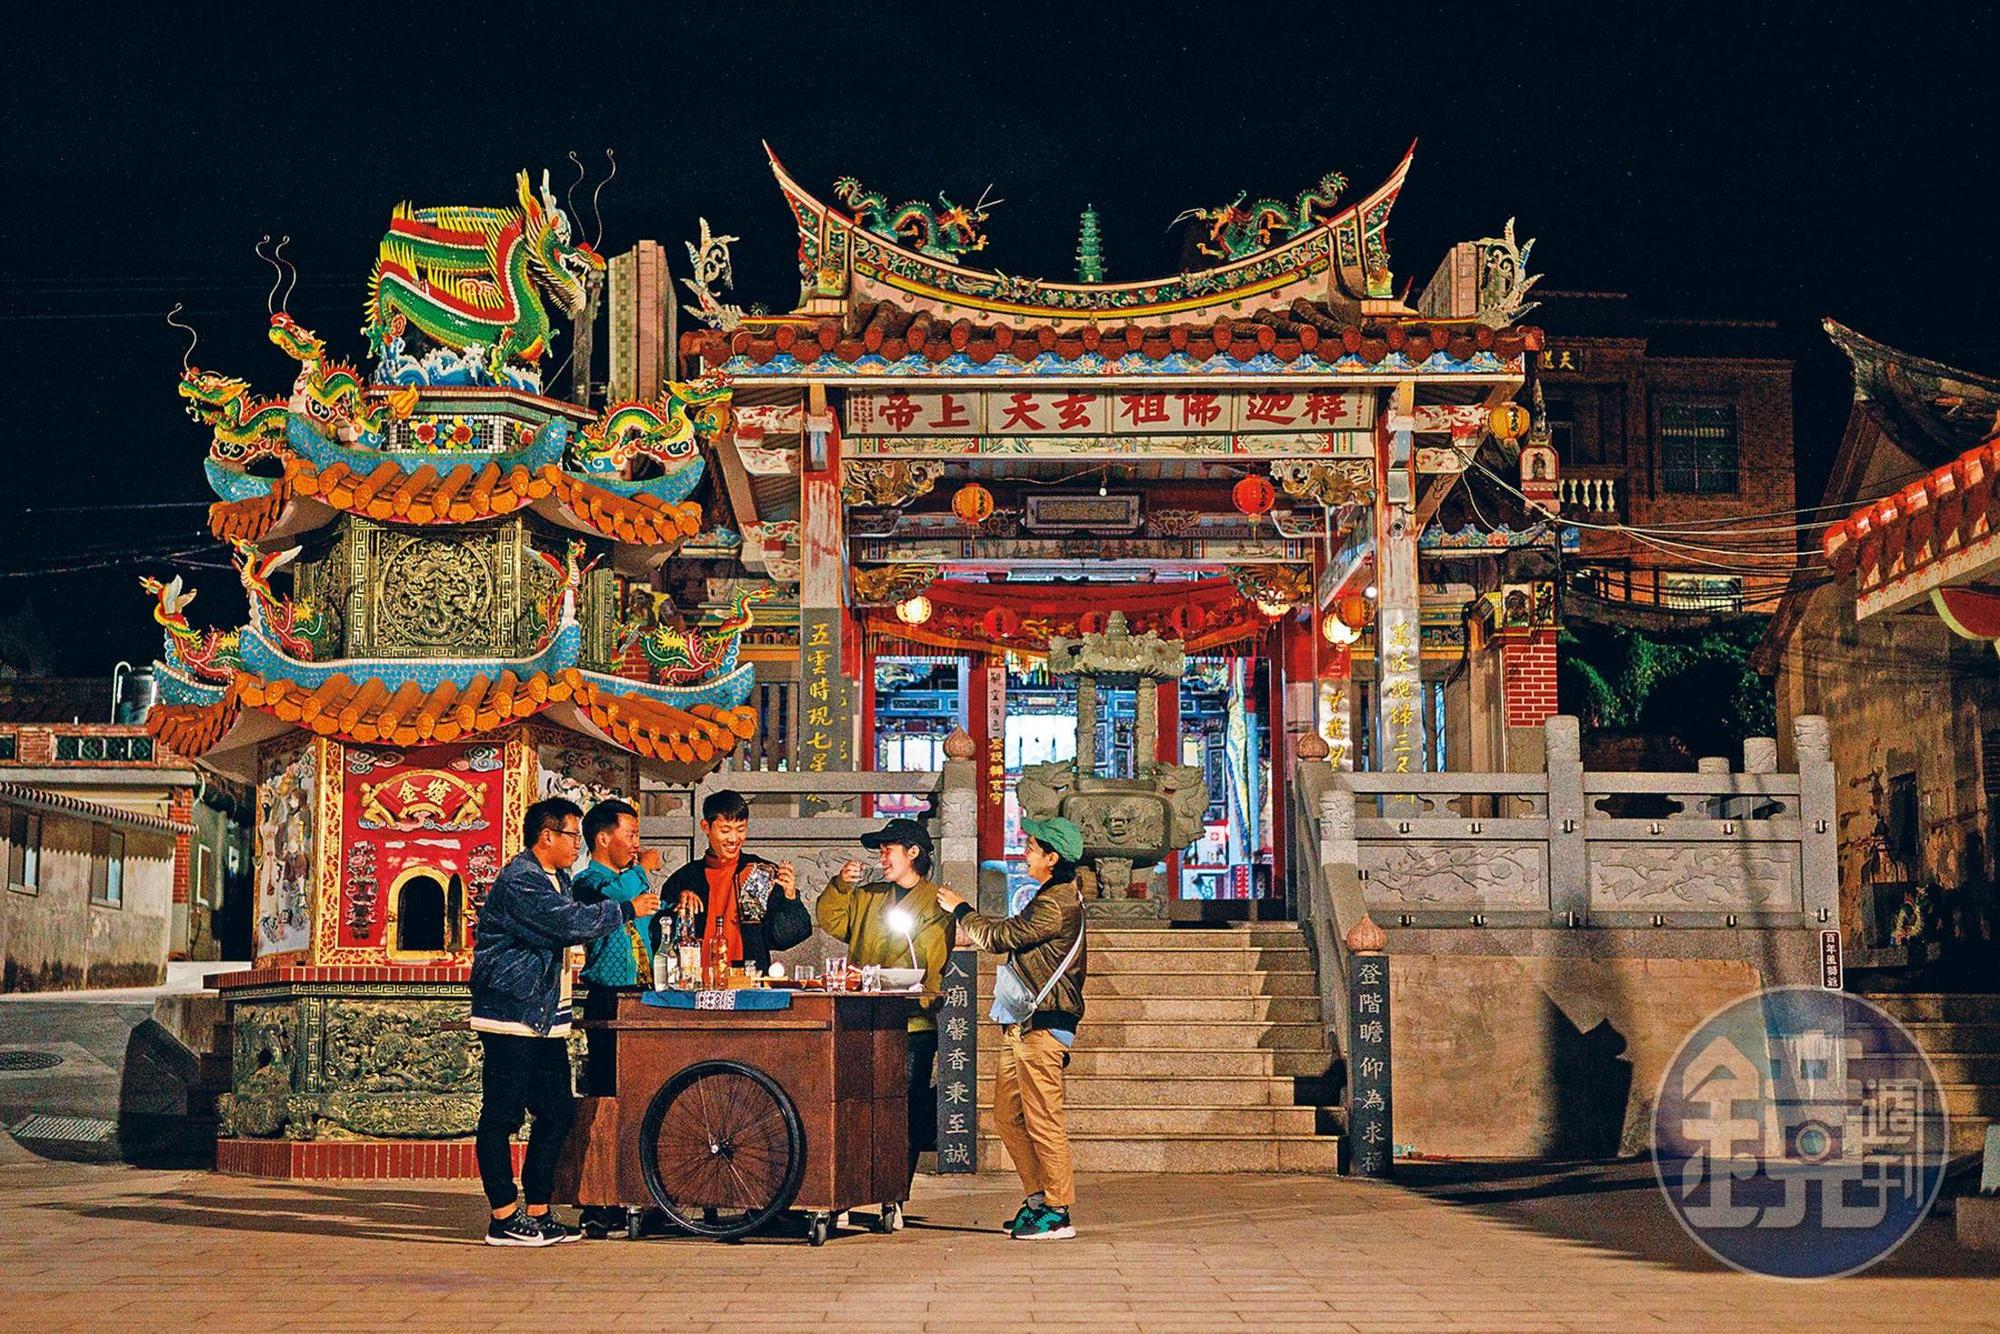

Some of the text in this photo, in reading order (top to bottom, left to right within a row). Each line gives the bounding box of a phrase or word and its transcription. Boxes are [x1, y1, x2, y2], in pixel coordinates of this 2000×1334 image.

[807, 622, 833, 803] 五雲時現七星
[1388, 620, 1415, 805] 萬法總歸三尺
[944, 961, 970, 1166] 入廟馨香秉至誠
[1358, 963, 1385, 1172] 登階瞻仰為求福
